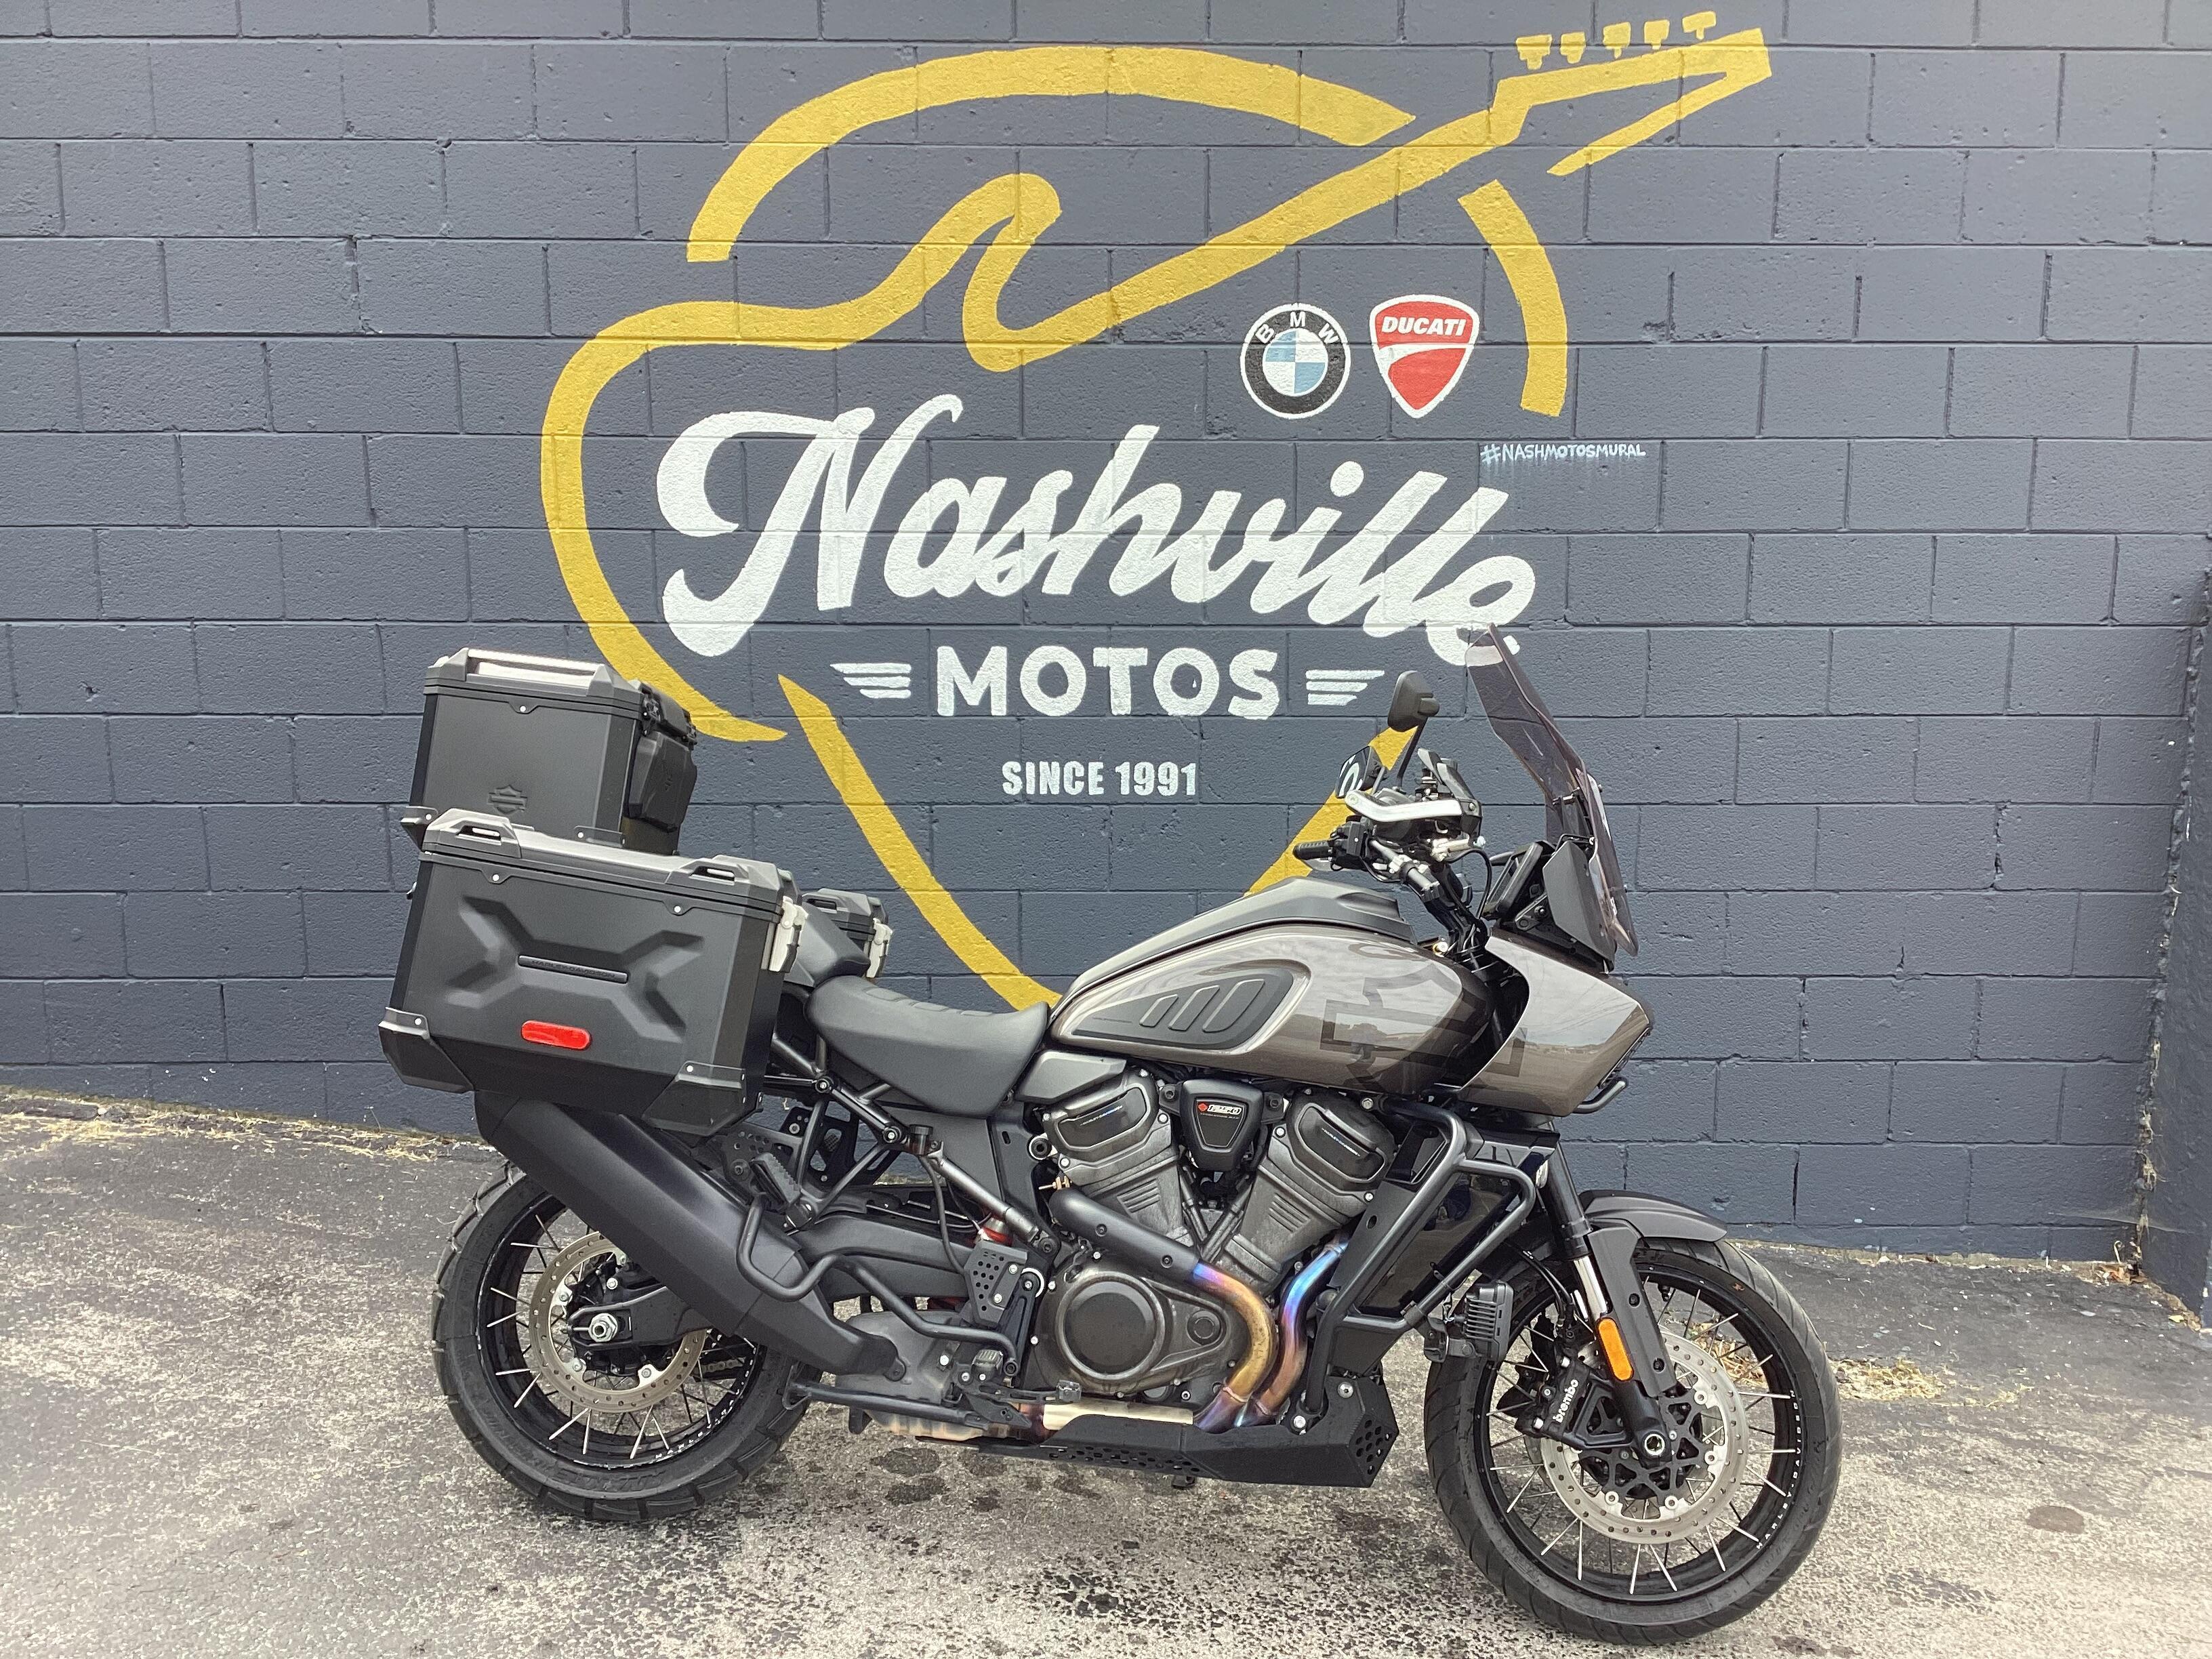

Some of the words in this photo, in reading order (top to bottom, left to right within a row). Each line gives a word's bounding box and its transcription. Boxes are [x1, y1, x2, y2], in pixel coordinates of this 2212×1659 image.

[1255, 311, 1339, 344] BMW
[1381, 316, 1467, 336] DUCATI
[1480, 443, 1647, 465] #NASHMOTOSMURAL
[656, 393, 1536, 667] Nashville
[937, 645, 1279, 720] MOTOS
[1002, 760, 1104, 796] SINCE
[1115, 761, 1196, 796] 1991
[1553, 1379, 1579, 1423] brembo
